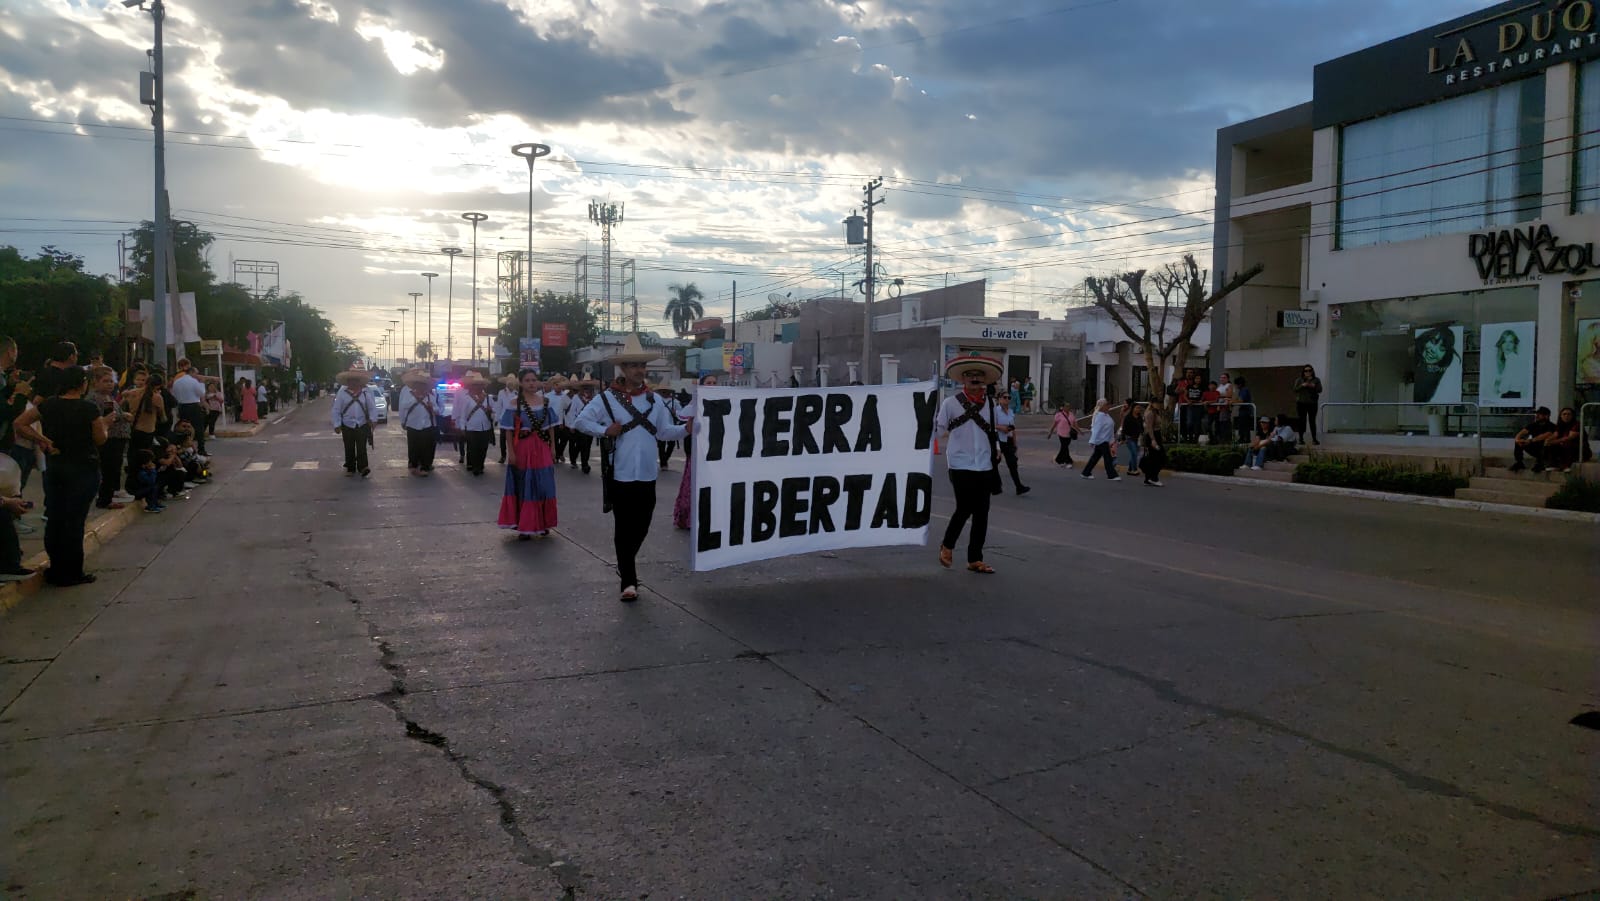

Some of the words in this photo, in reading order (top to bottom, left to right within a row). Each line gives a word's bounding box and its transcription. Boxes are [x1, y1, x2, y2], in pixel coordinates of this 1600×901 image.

[1427, 37, 1477, 74] LA
[1445, 32, 1599, 85] RESTAURANT
[1468, 224, 1554, 258] DIANA
[981, 327, 1029, 339] di-water
[702, 393, 882, 461] TIERRA
[912, 390, 937, 450] Y
[697, 472, 933, 553] LIBERTAD
